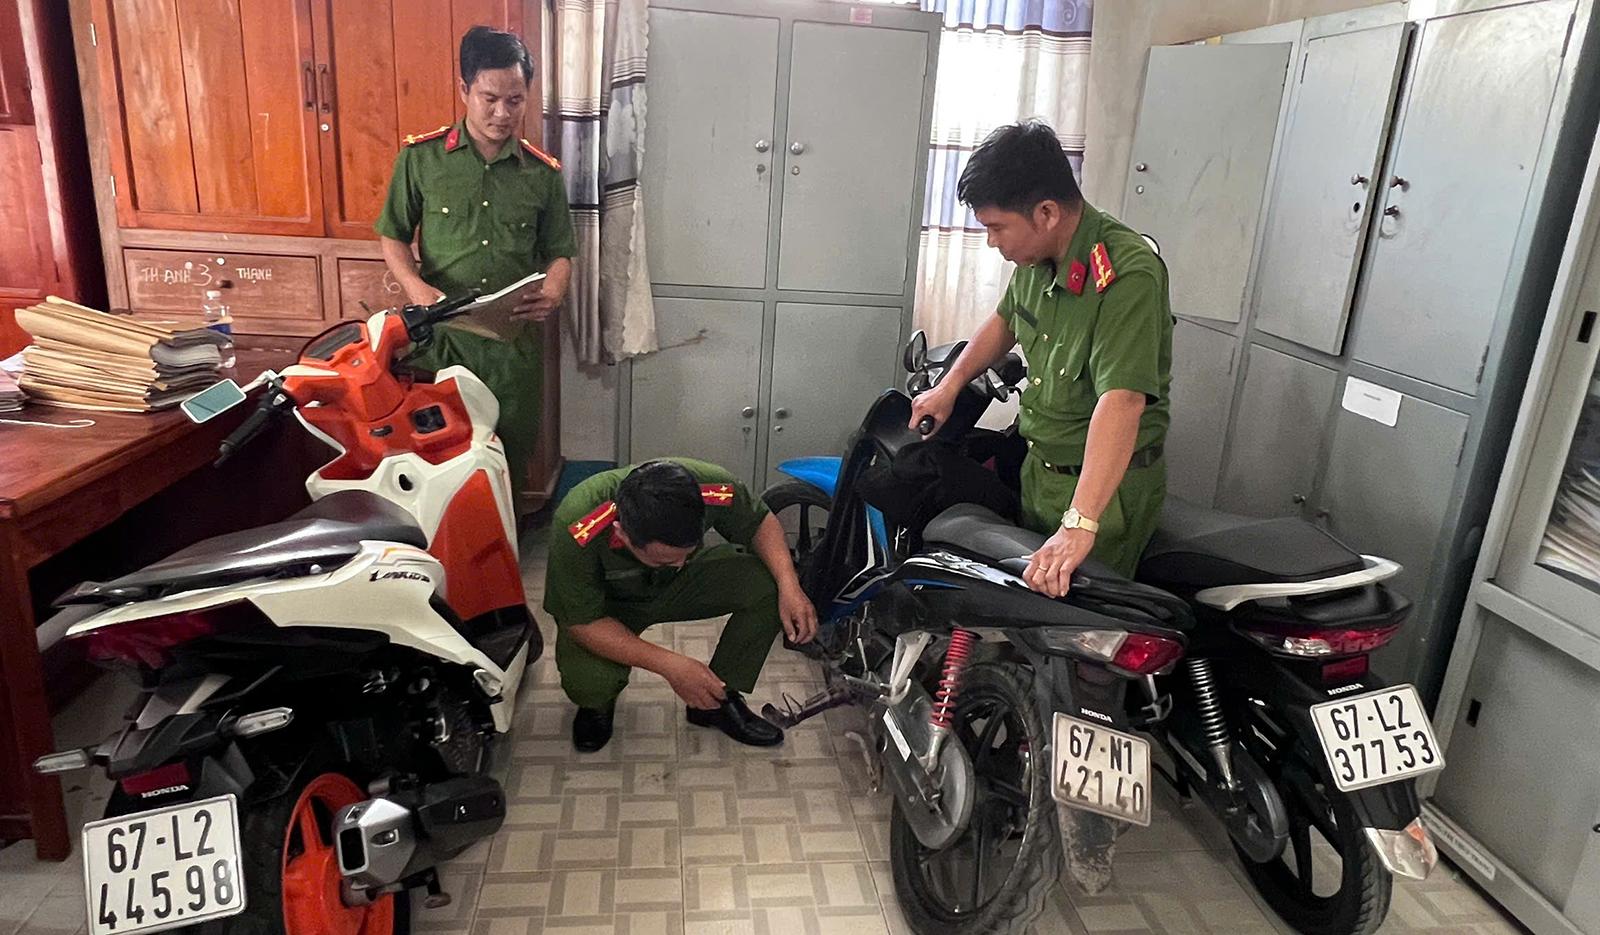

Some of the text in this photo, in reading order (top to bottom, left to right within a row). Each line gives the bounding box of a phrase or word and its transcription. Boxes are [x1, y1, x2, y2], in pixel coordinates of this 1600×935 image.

[193, 263, 213, 286] 3
[1327, 683, 1364, 696] HONDA
[1081, 708, 1113, 722] HONDA
[1330, 695, 1411, 741] 67-L2
[1334, 730, 1434, 782] 377.53
[141, 784, 189, 798] HONDA
[1059, 760, 1144, 813] 421.40
[107, 809, 216, 873] 67-L2
[99, 859, 234, 930] 445.98
